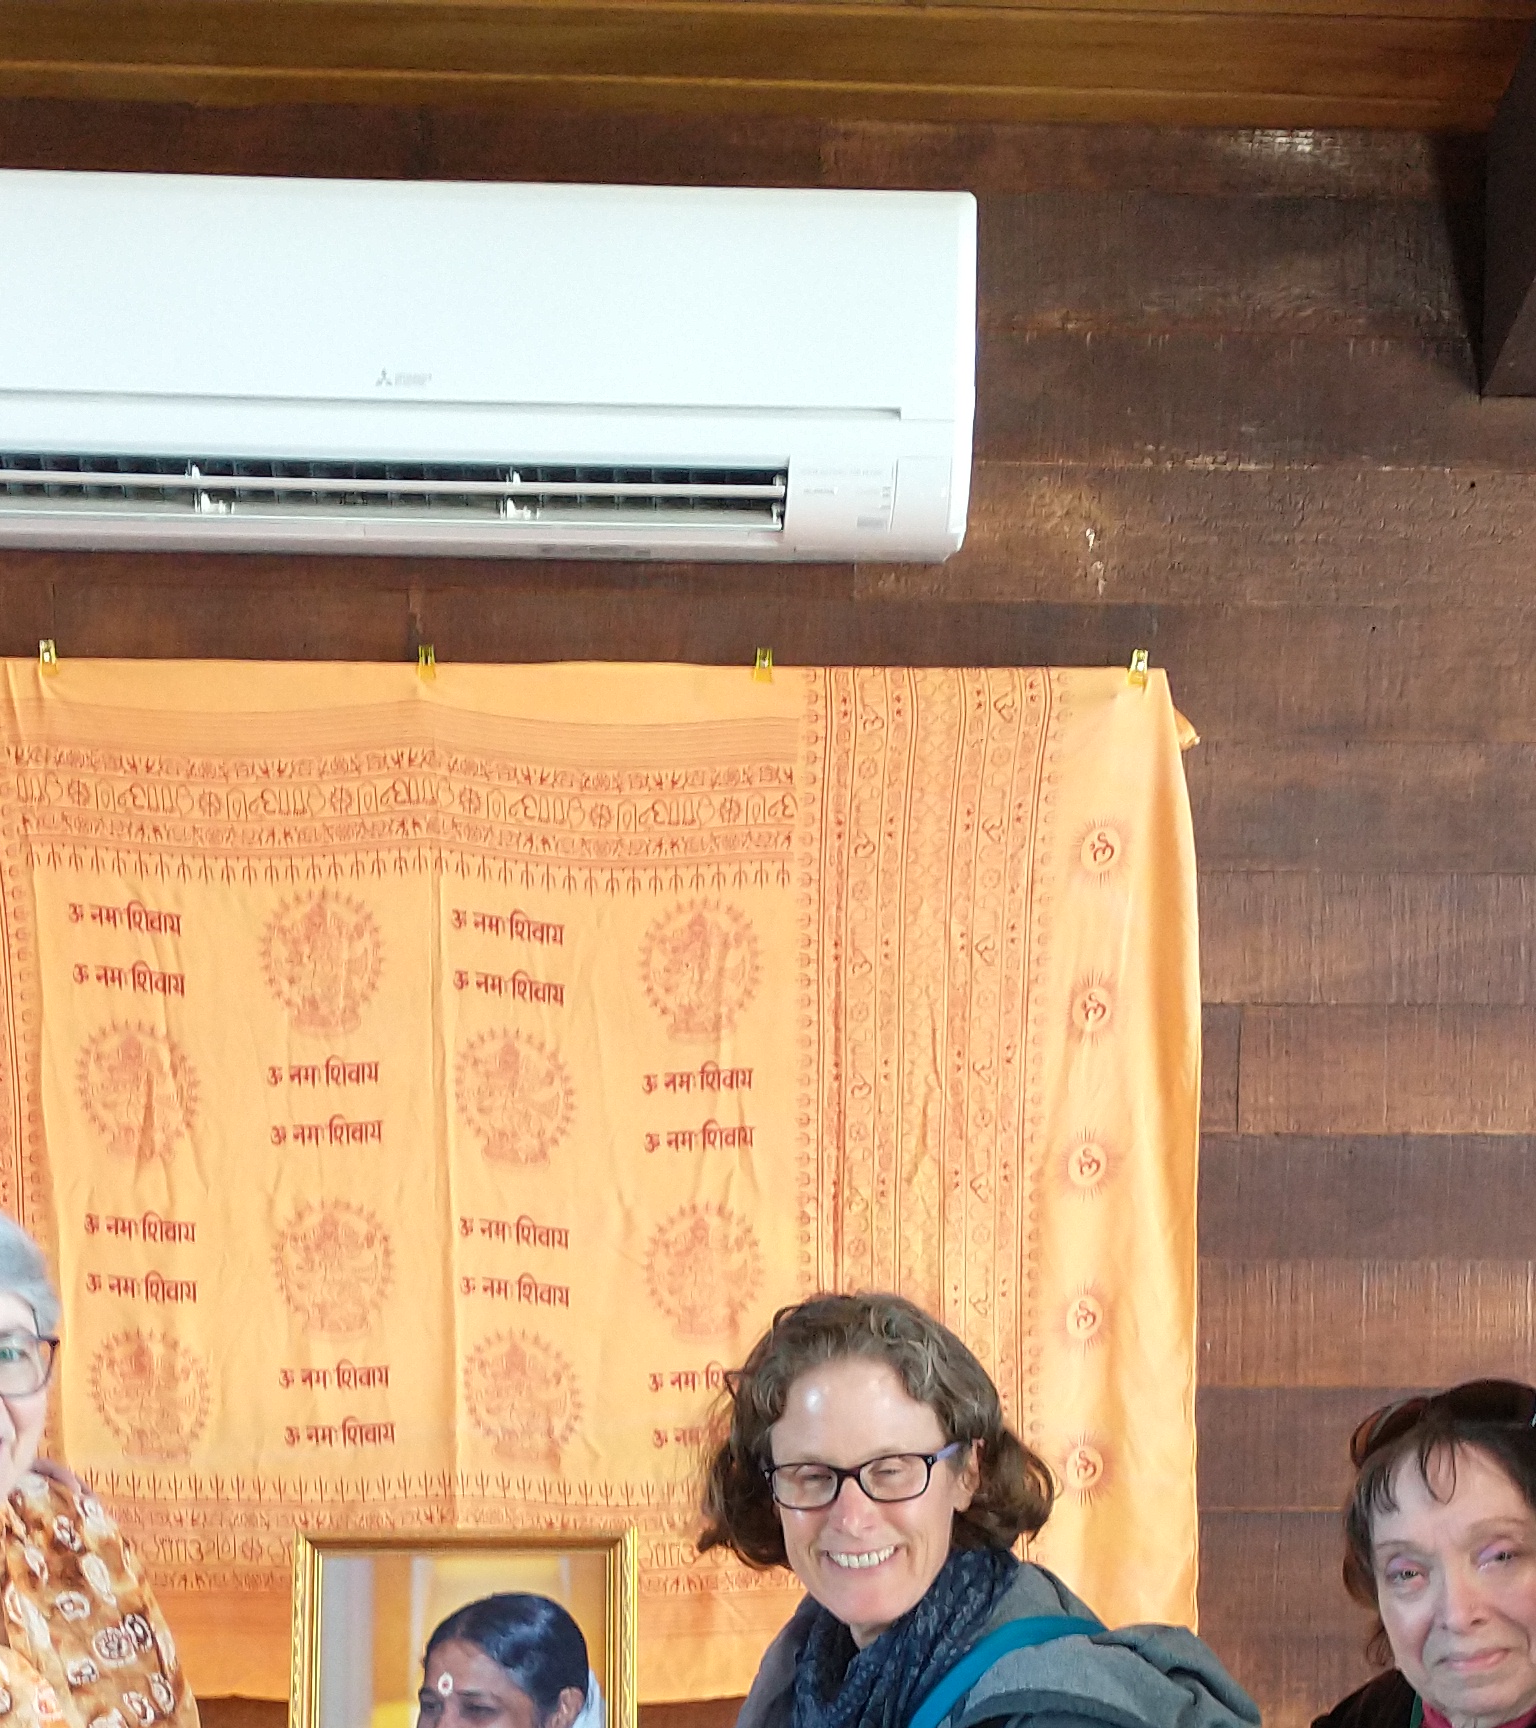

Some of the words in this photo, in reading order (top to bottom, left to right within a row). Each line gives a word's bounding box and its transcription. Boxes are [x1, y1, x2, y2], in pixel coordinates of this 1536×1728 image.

[126, 899, 182, 937] शिवाय
[509, 908, 565, 947] शिवाय
[131, 960, 186, 998] शिवाय
[511, 969, 565, 1007] शिवाय
[325, 1054, 379, 1087] शिवाय
[699, 1060, 754, 1091] शिवाय
[328, 1114, 383, 1145] शिवाय
[701, 1119, 756, 1150] शिवाय
[142, 1210, 197, 1244] शिवाय
[515, 1215, 570, 1250] शिवाय
[144, 1270, 198, 1304] शिवाय
[517, 1272, 570, 1308] शिवाय
[336, 1358, 390, 1390] शिवाय
[342, 1415, 396, 1448] शिवाय
